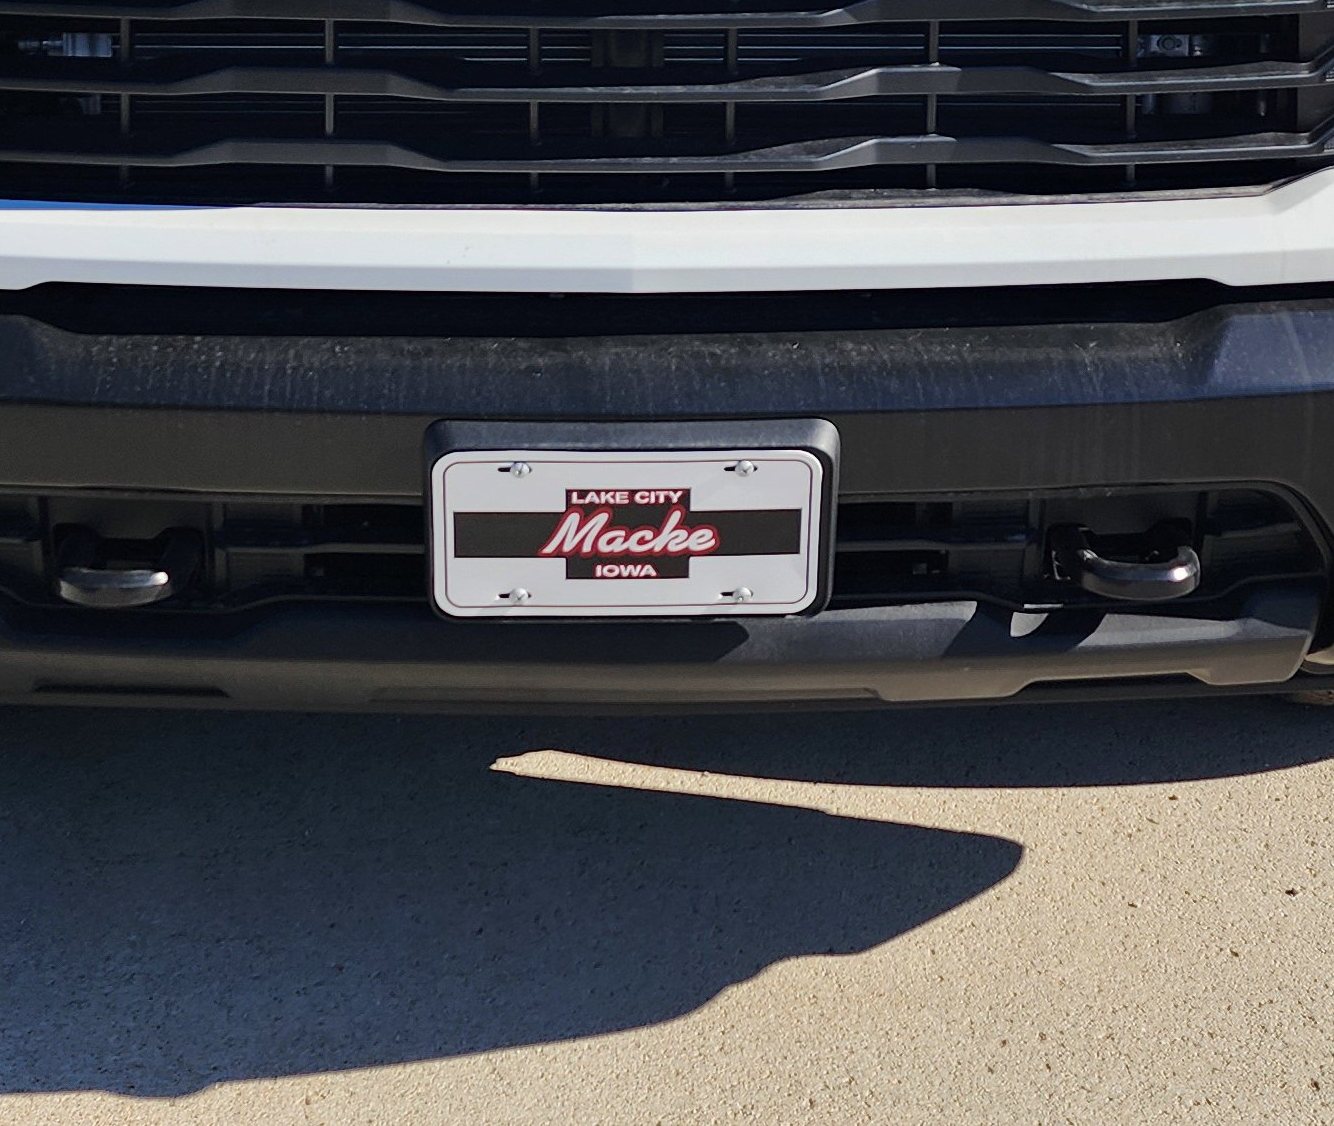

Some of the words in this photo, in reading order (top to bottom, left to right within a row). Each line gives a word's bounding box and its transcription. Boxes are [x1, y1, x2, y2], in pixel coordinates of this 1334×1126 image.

[570, 491, 629, 504] LAKE
[633, 490, 682, 504] CITY
[542, 510, 716, 554] Macke
[595, 564, 657, 578] IOWA
